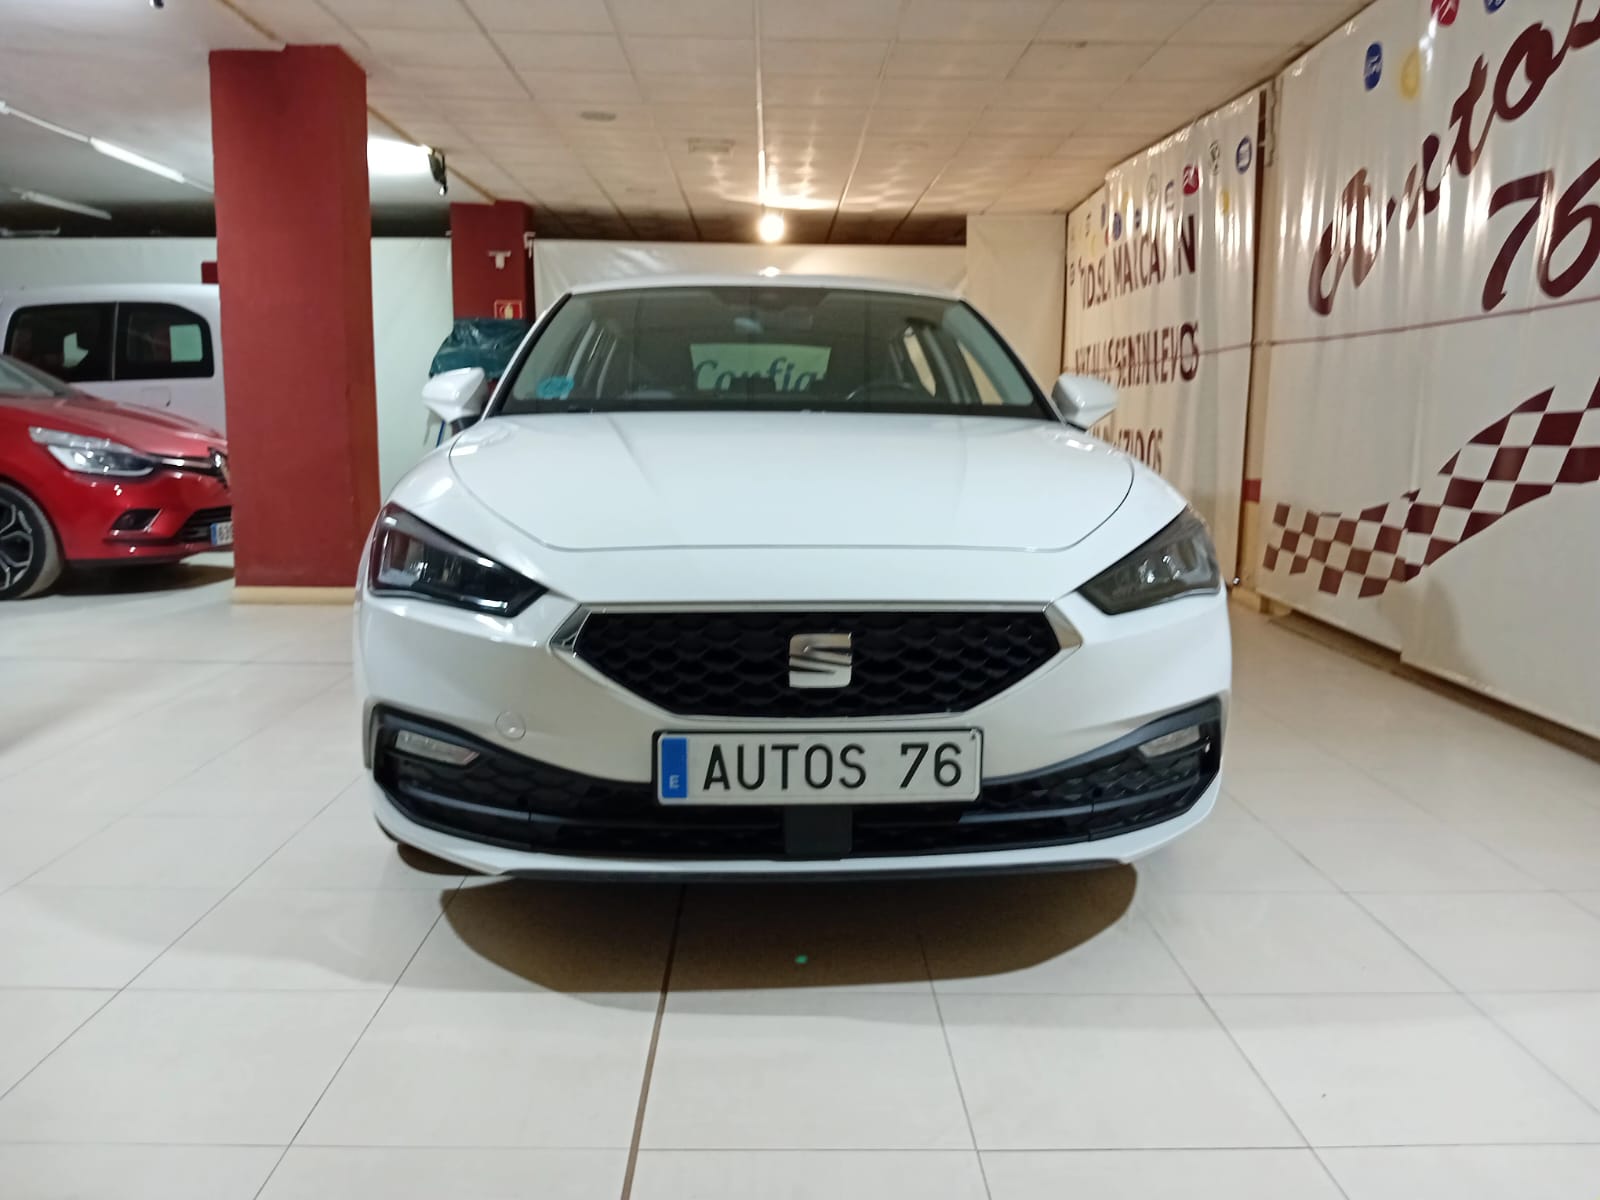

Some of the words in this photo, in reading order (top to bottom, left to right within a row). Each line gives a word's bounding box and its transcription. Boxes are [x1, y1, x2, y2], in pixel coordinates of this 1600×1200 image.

[1482, 158, 1600, 311] 76
[703, 743, 866, 790] AUTOS
[900, 742, 961, 788] 76
